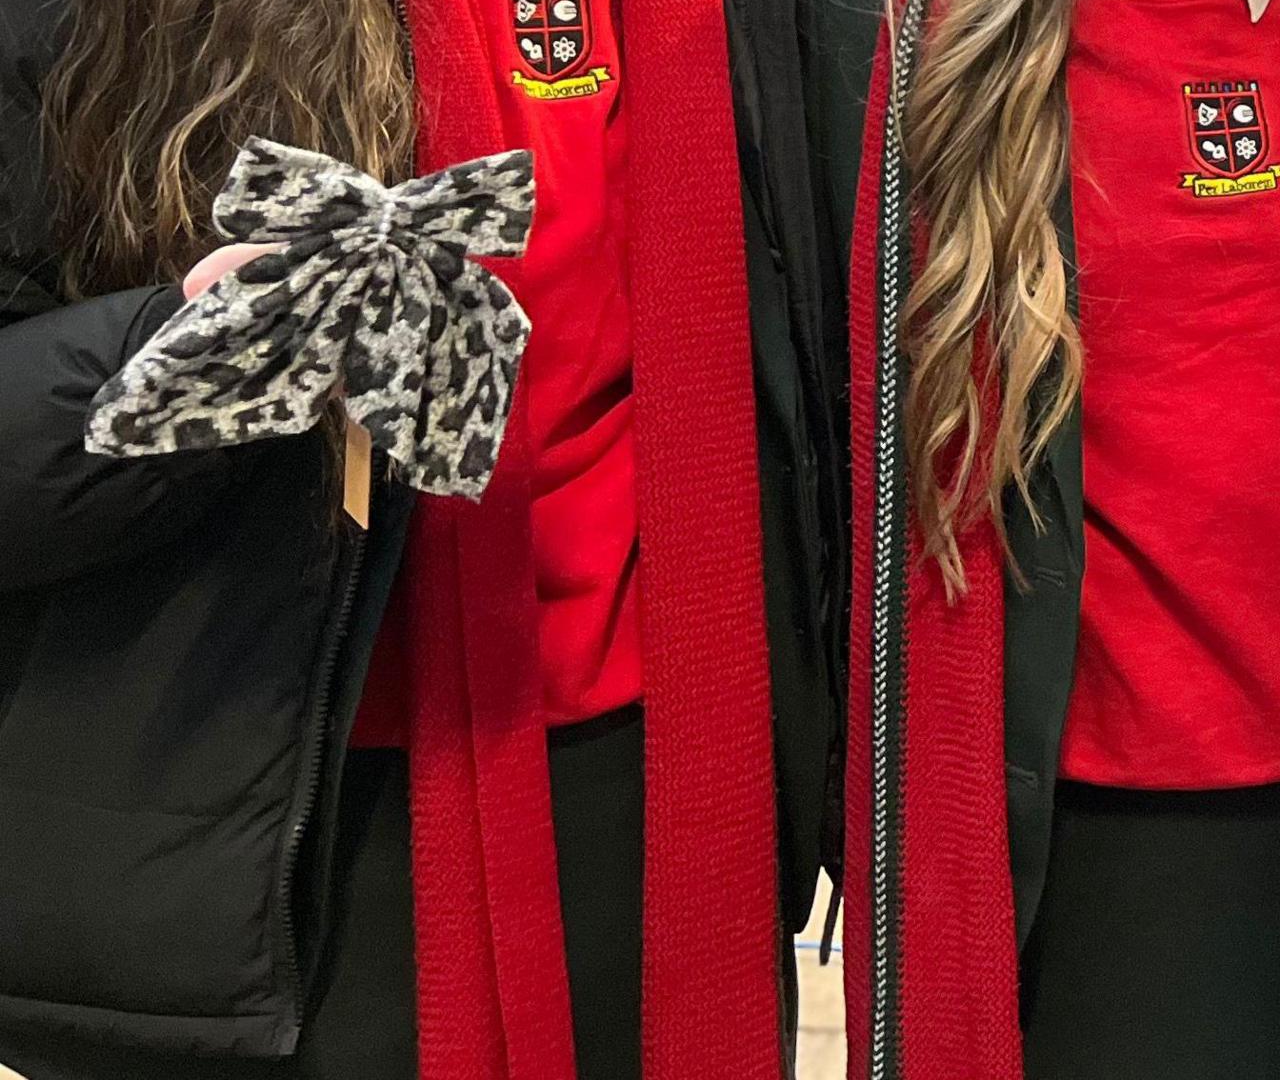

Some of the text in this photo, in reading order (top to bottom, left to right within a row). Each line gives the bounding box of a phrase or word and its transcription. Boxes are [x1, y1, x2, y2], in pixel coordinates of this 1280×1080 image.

[539, 83, 595, 98] Laborem
[1198, 178, 1274, 196] Per Laborem
